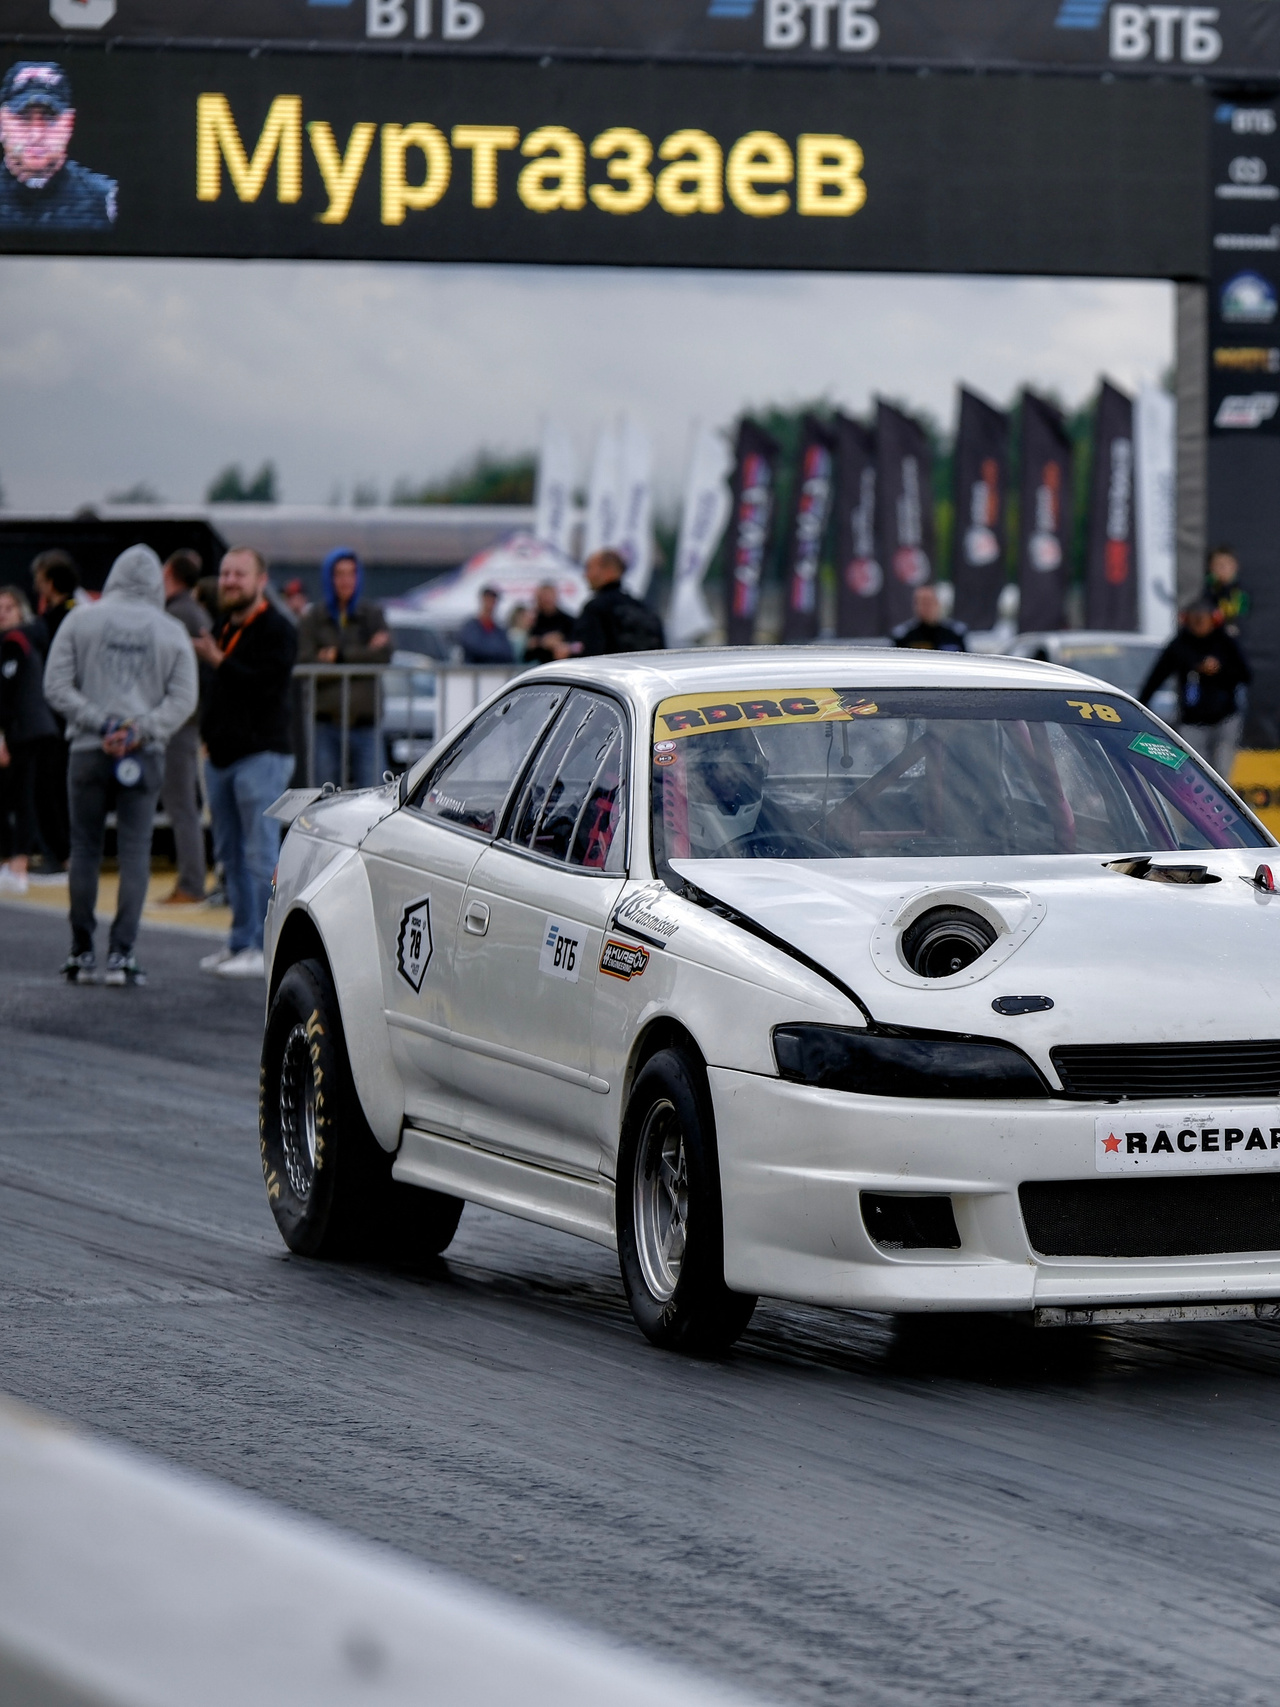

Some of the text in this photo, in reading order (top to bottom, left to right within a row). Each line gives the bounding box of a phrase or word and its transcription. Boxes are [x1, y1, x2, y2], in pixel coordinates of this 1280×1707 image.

[763, 0, 880, 51] ВТБ
[1109, 3, 1223, 64] ВТБ
[197, 92, 867, 225] Муртазаев
[659, 697, 820, 732] RDRC
[1066, 700, 1122, 723] 78
[410, 928, 422, 960] 78
[553, 935, 578, 972] ВТБ
